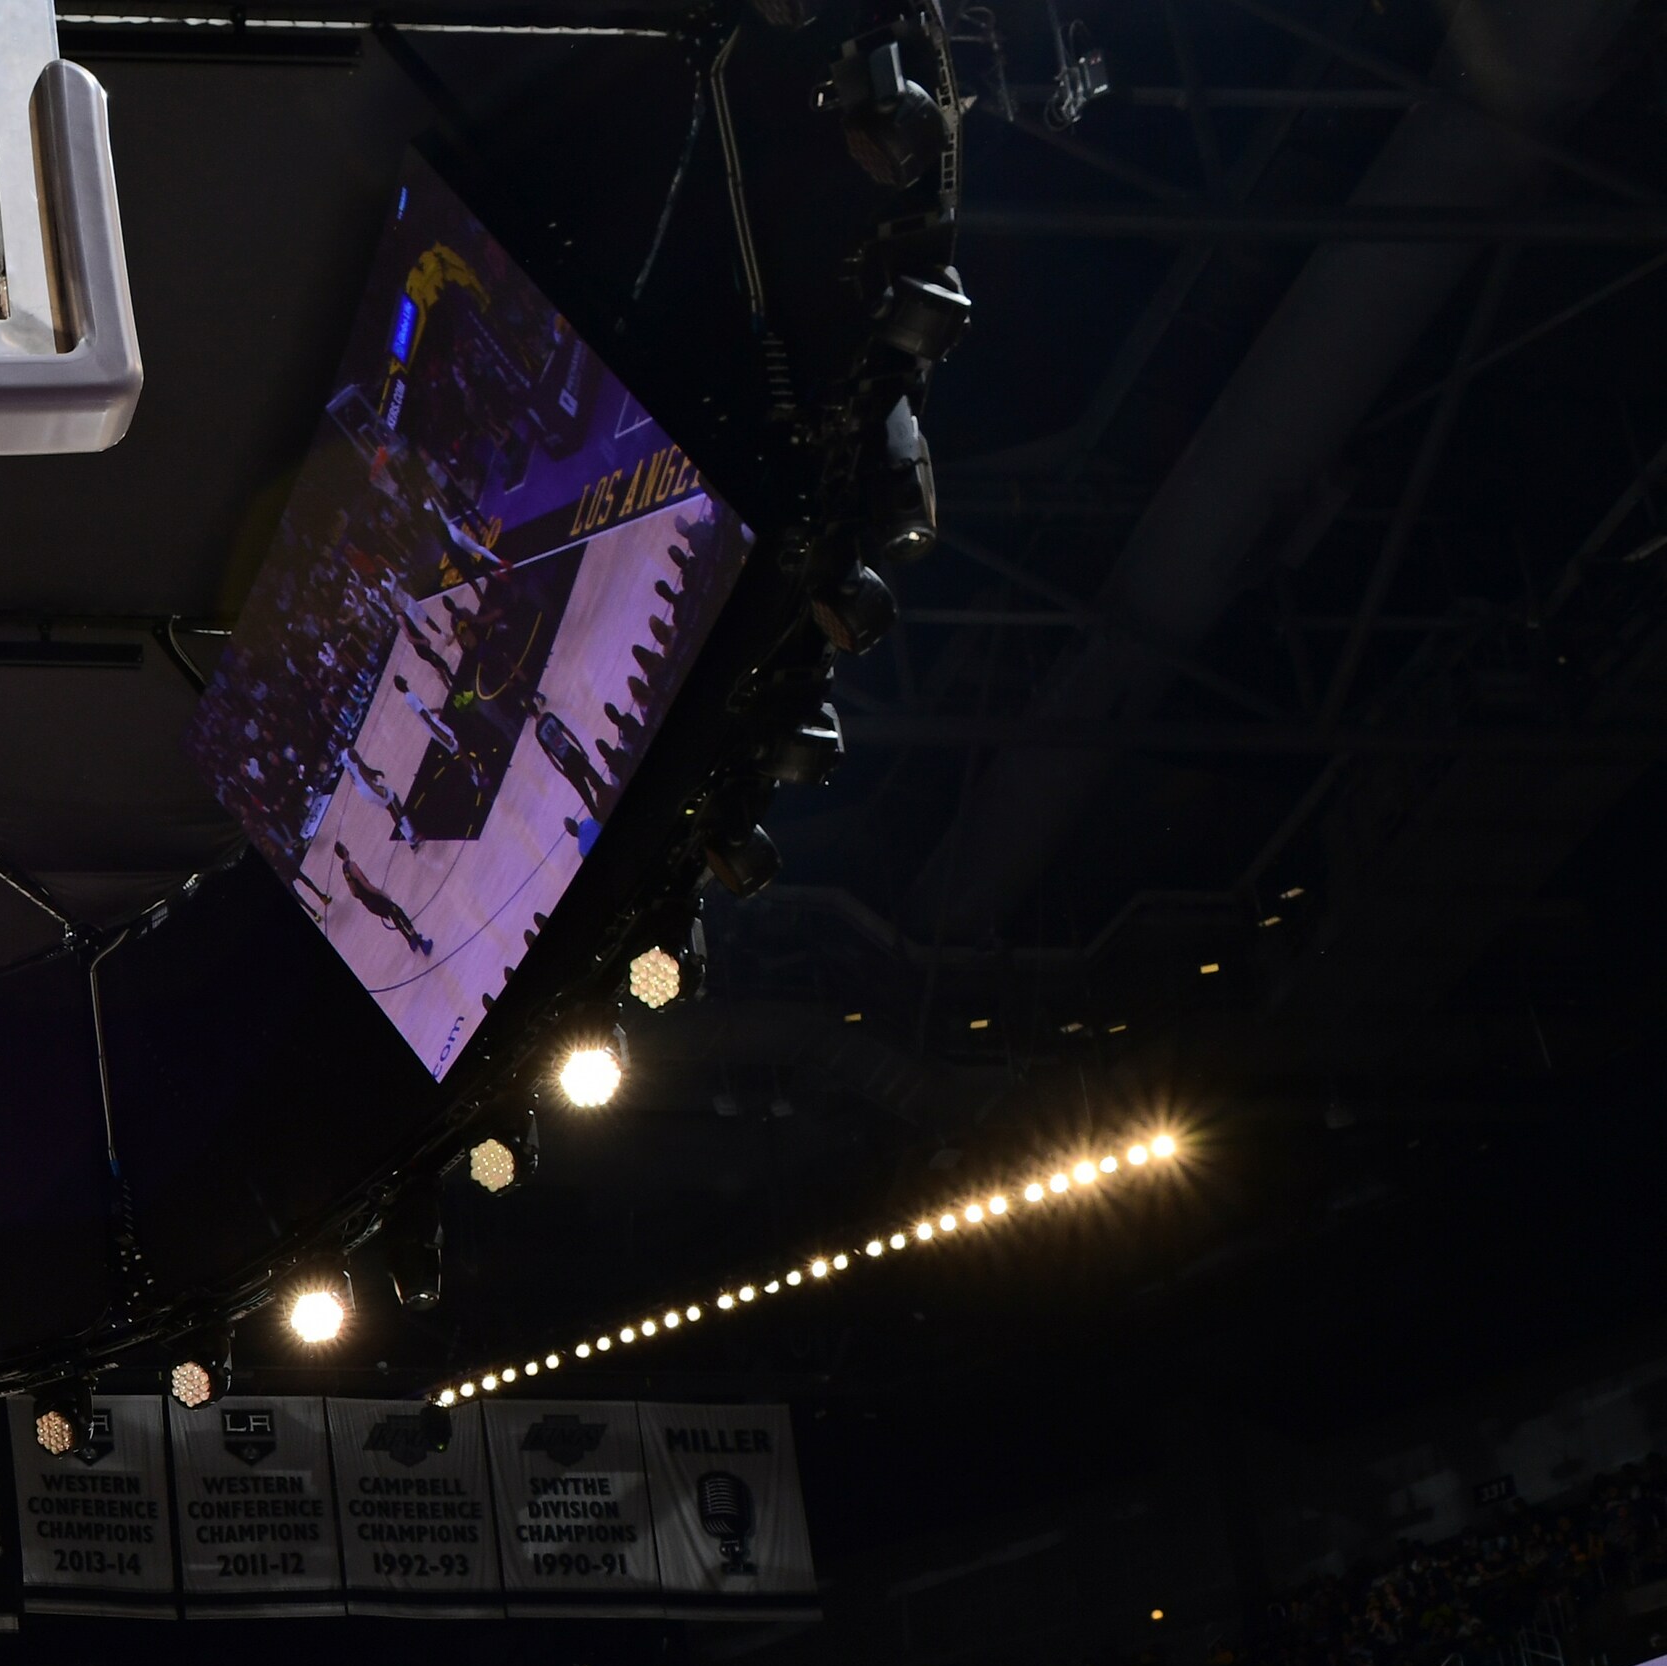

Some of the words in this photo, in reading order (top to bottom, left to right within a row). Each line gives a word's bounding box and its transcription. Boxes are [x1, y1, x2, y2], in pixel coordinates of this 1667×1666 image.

[224, 1414, 272, 1432] LA
[666, 1428, 772, 1454] MILLER
[43, 1475, 140, 1495] WESTERN
[203, 1476, 303, 1494] WESTERN
[359, 1478, 466, 1496] CAMPBELL
[531, 1478, 611, 1496] SMYTHE
[28, 1498, 158, 1519] CONFERENCE
[188, 1500, 323, 1520] CONFERENCE
[349, 1501, 482, 1519] CONFERENCE
[529, 1501, 618, 1519] DIVISION
[37, 1521, 153, 1543] CHAMPIONS
[196, 1524, 319, 1544] CHAMPIONS
[357, 1525, 478, 1543] CHAMPIONS
[516, 1525, 636, 1543] CHAMPIONS
[54, 1550, 141, 1575] 2013-14
[217, 1553, 305, 1577] 2011-12
[373, 1553, 470, 1576] 1992-93
[533, 1554, 627, 1576] 1990-91
